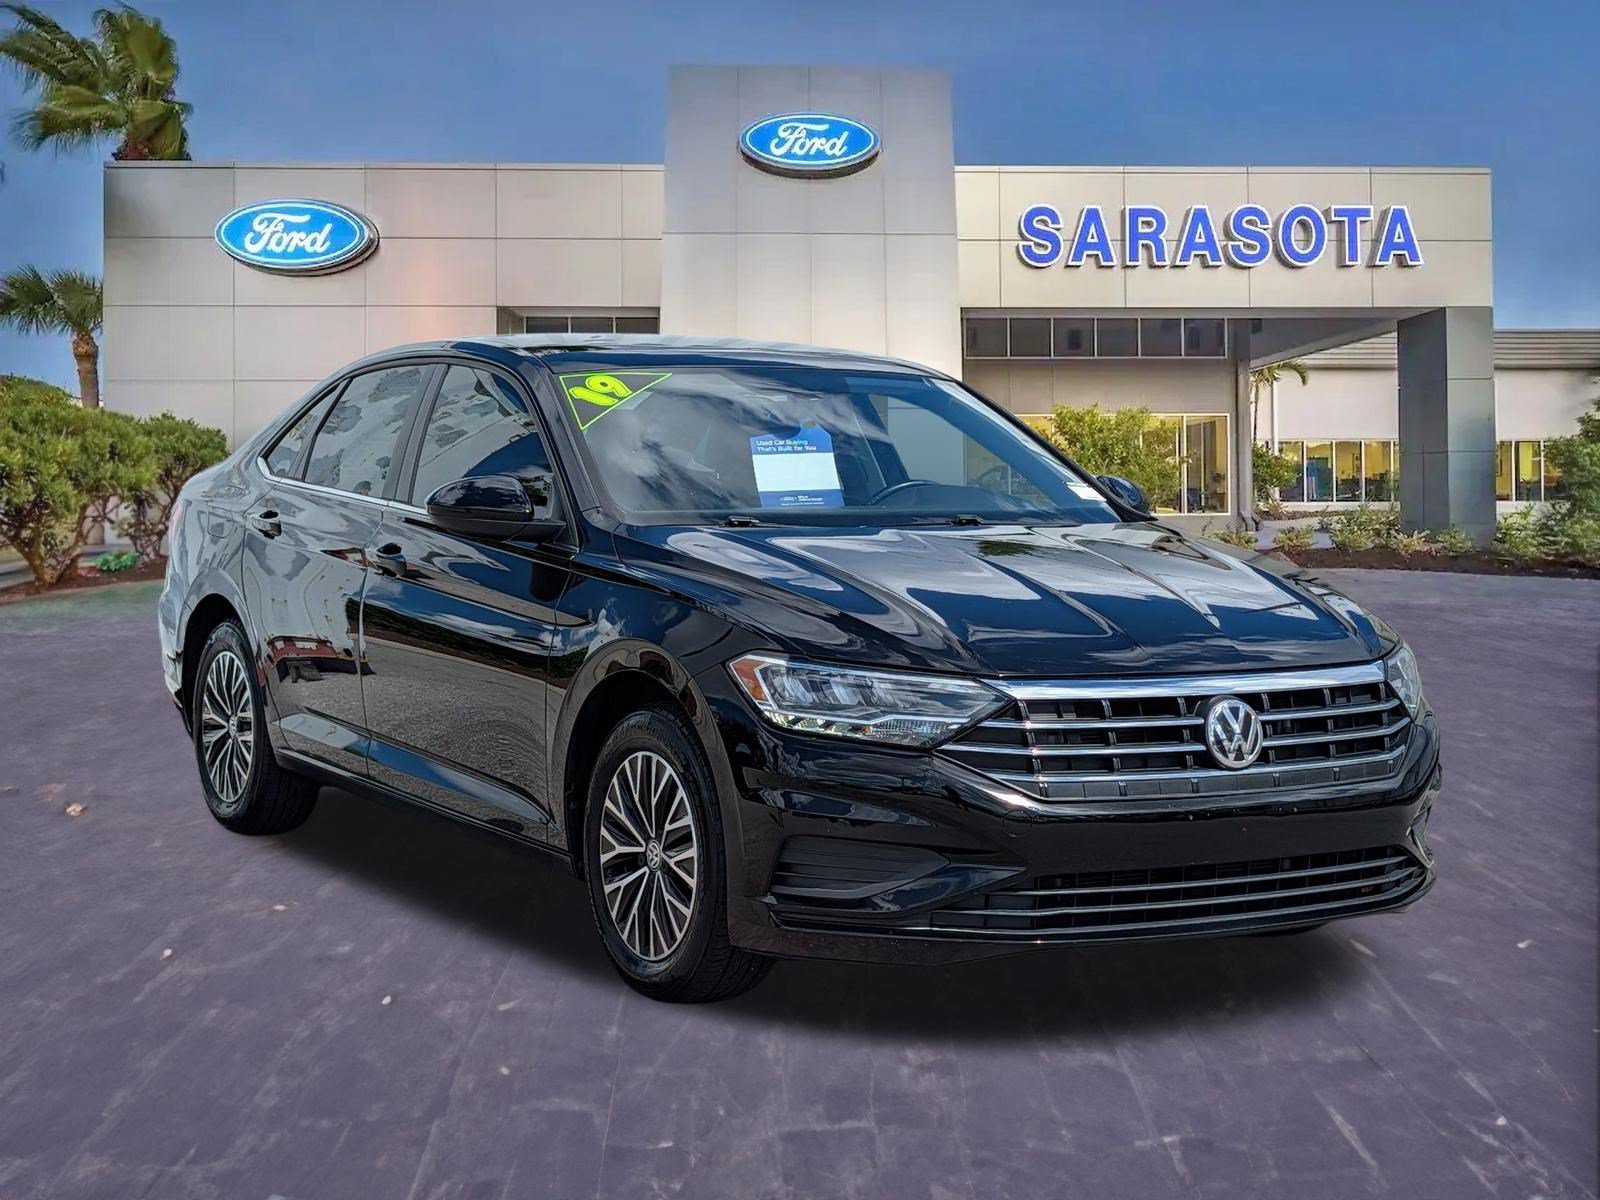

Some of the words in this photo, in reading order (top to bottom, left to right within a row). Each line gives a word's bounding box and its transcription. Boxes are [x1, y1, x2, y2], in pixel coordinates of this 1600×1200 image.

[770, 122, 849, 156] Ford
[244, 212, 333, 253] Ford
[1018, 203, 1425, 268] SARASOTA
[569, 375, 633, 406] 19
[785, 439, 809, 447] Buying
